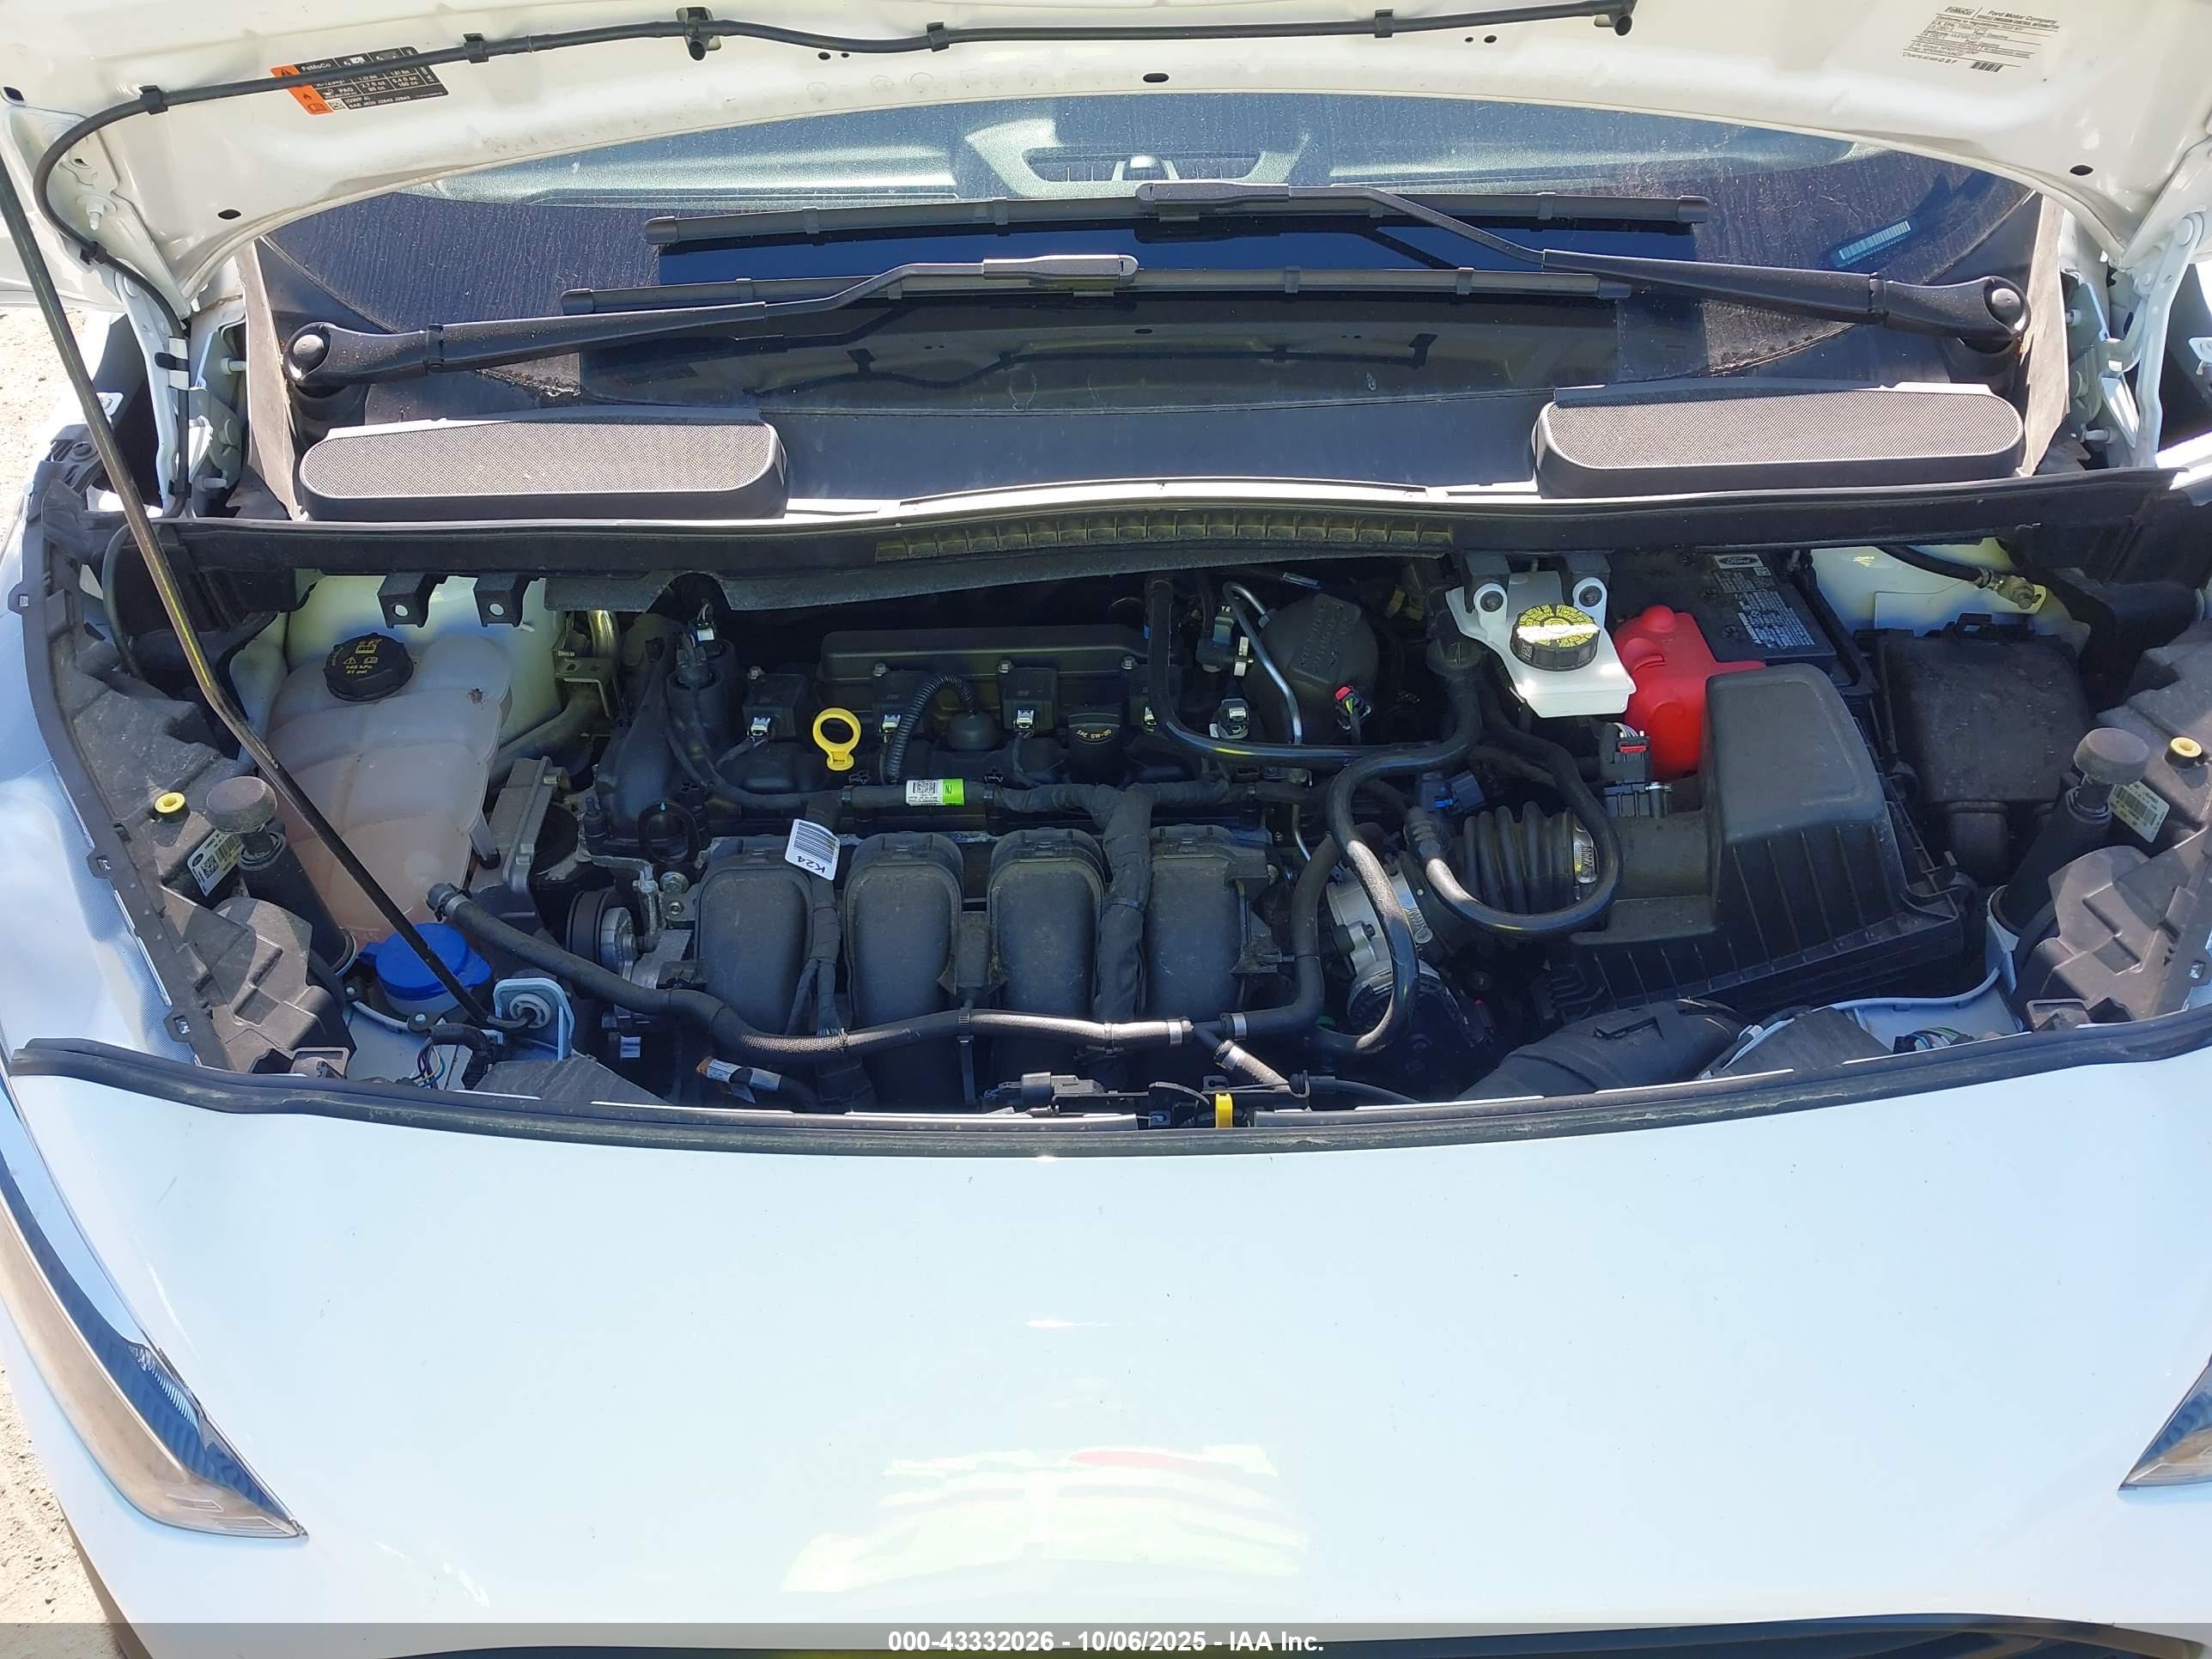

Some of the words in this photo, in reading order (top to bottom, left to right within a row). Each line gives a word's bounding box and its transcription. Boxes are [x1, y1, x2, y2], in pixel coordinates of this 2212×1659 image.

[2026, 15, 2059, 25] Company
[1091, 729, 1112, 738] 5W-20
[945, 784, 953, 795] NJ
[797, 855, 826, 873] K24
